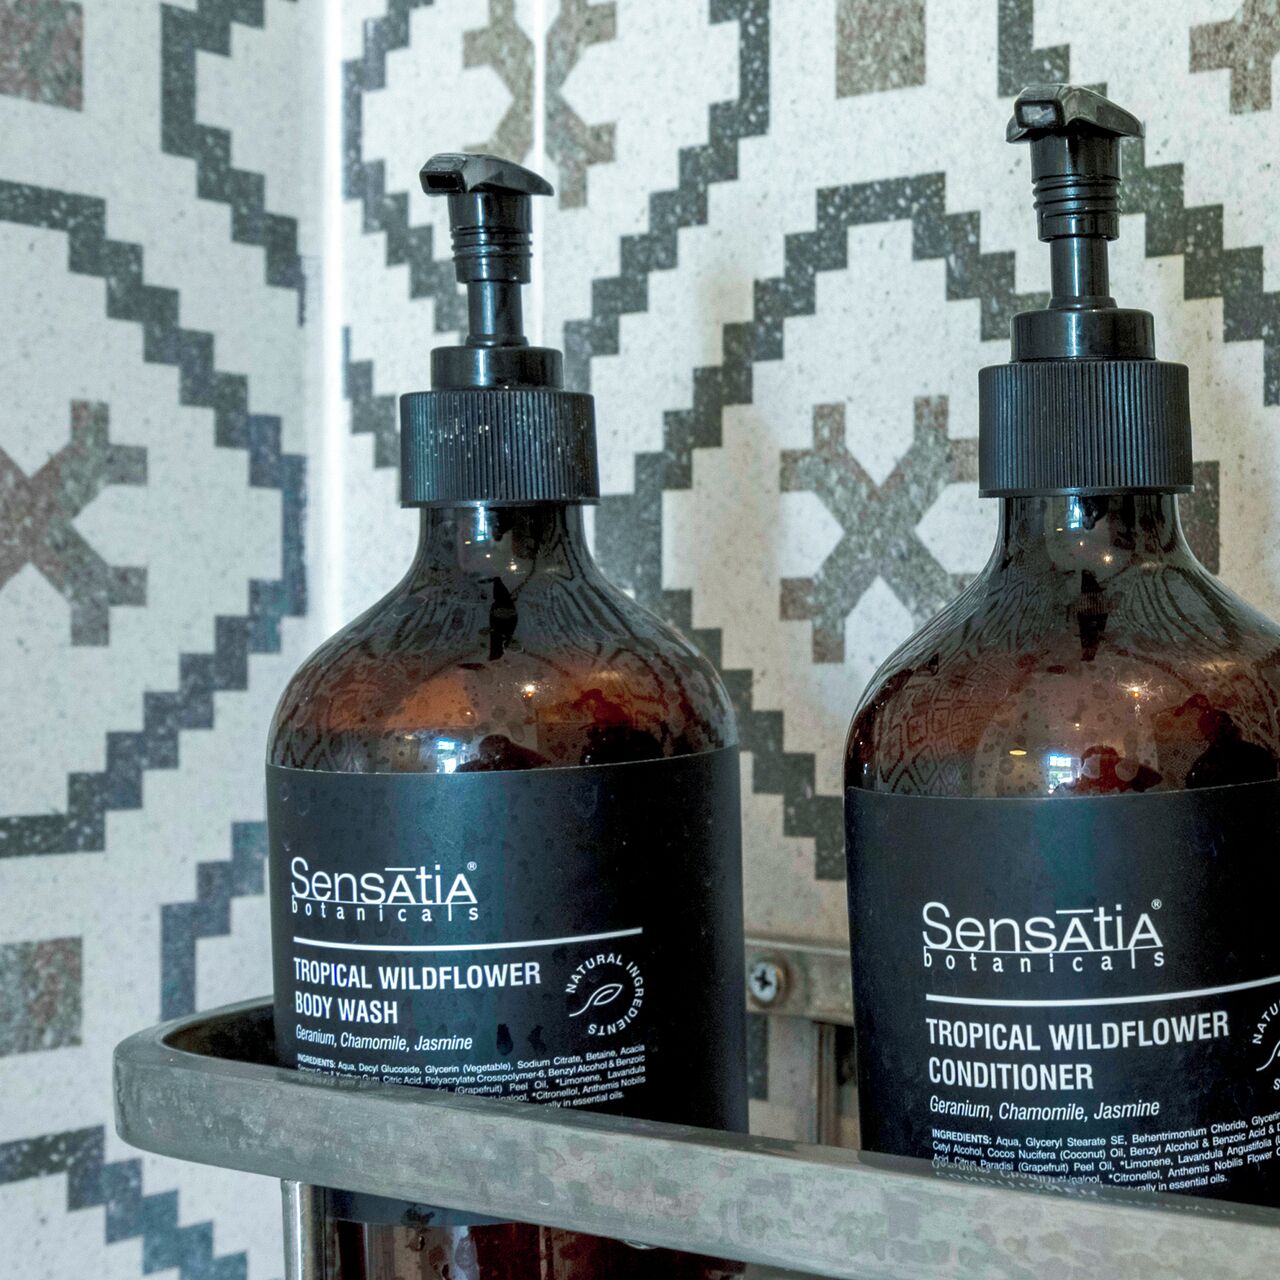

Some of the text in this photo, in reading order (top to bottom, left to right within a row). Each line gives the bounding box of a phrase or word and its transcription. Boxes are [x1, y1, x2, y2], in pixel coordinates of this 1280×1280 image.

[292, 895, 479, 922] botanicals
[294, 957, 541, 990] TROPICAL WILDFLOWER
[923, 946, 1165, 973] botanicals
[295, 991, 398, 1024] BODY WASH
[565, 953, 644, 1036] NATURAL INGREDIENTS
[296, 1024, 473, 1052] Geranium, Chamomile, Jasmine
[926, 1010, 1229, 1051] TROPICAL WILDFLOWER
[297, 1053, 336, 1068] INGREDIENTS:
[338, 1061, 357, 1072] Aqua,
[359, 1064, 379, 1074] Decyl
[381, 1065, 422, 1075] Glucoside,
[425, 1065, 459, 1075] Glycerin
[463, 1062, 514, 1074] (Vegetable),
[517, 1059, 550, 1069] Sodium
[553, 1055, 583, 1065] Citrate,
[586, 1050, 618, 1061] Betaine,
[620, 1044, 645, 1055] Acacia
[404, 1076, 423, 1085] Acid,
[425, 1075, 476, 1085] Polyacrylate
[477, 1069, 547, 1083] Crosspolymer-6,
[548, 1065, 577, 1077] Benzyl
[577, 1061, 608, 1073] Alcohol
[608, 1058, 615, 1068] &
[616, 1055, 645, 1067] Benzoic
[928, 1056, 1094, 1091] CONDITIONER
[509, 1082, 528, 1091] Peel
[534, 1080, 549, 1089] Oil,
[608, 1065, 646, 1079] Lavandula
[582, 1081, 619, 1094] Anthemis
[621, 1075, 646, 1088] Nobilis
[563, 1099, 571, 1107] in
[573, 1094, 608, 1106] essential
[609, 1091, 624, 1099] oils.
[930, 1093, 1160, 1123] Geranium, Chamomile, Jasmine
[932, 1129, 992, 1145] INGREDIENTS:
[996, 1136, 1021, 1147] Aqua,
[1025, 1138, 1062, 1148] Glyceryl
[1067, 1138, 1106, 1147] Stearate
[1111, 1135, 1128, 1145] SE,
[1132, 1127, 1207, 1144] Behentrimonium
[1210, 1120, 1248, 1134] Chloride,
[933, 1141, 950, 1153] Cetyl
[953, 1144, 984, 1157] Alcohol,
[988, 1147, 1015, 1158] Cocos
[1018, 1149, 1056, 1160] Nucifera
[1060, 1150, 1106, 1160] (Coconut)
[1110, 1147, 1126, 1157] Oil,
[1130, 1145, 1162, 1156] Benzyl
[1165, 1140, 1199, 1153] Alcohol
[1202, 1139, 1209, 1148] &
[1212, 1133, 1246, 1147] Benzoic
[1248, 1127, 1266, 1139] Acid
[1268, 1125, 1275, 1135] &
[980, 1160, 1014, 1170] Paradisi
[1018, 1163, 1068, 1172] (Grapefruit)
[1074, 1163, 1094, 1171] Peel
[1099, 1162, 1115, 1170] Oil,
[1178, 1149, 1223, 1164] Lavandula
[1226, 1139, 1272, 1156] Angustifolia
[1168, 1165, 1210, 1178] Anthemis
[1214, 1158, 1243, 1171] Nobilis
[1247, 1151, 1272, 1164] Flower
[1158, 1181, 1167, 1191] in
[1169, 1175, 1208, 1189] essential
[1210, 1174, 1228, 1184] oils.
